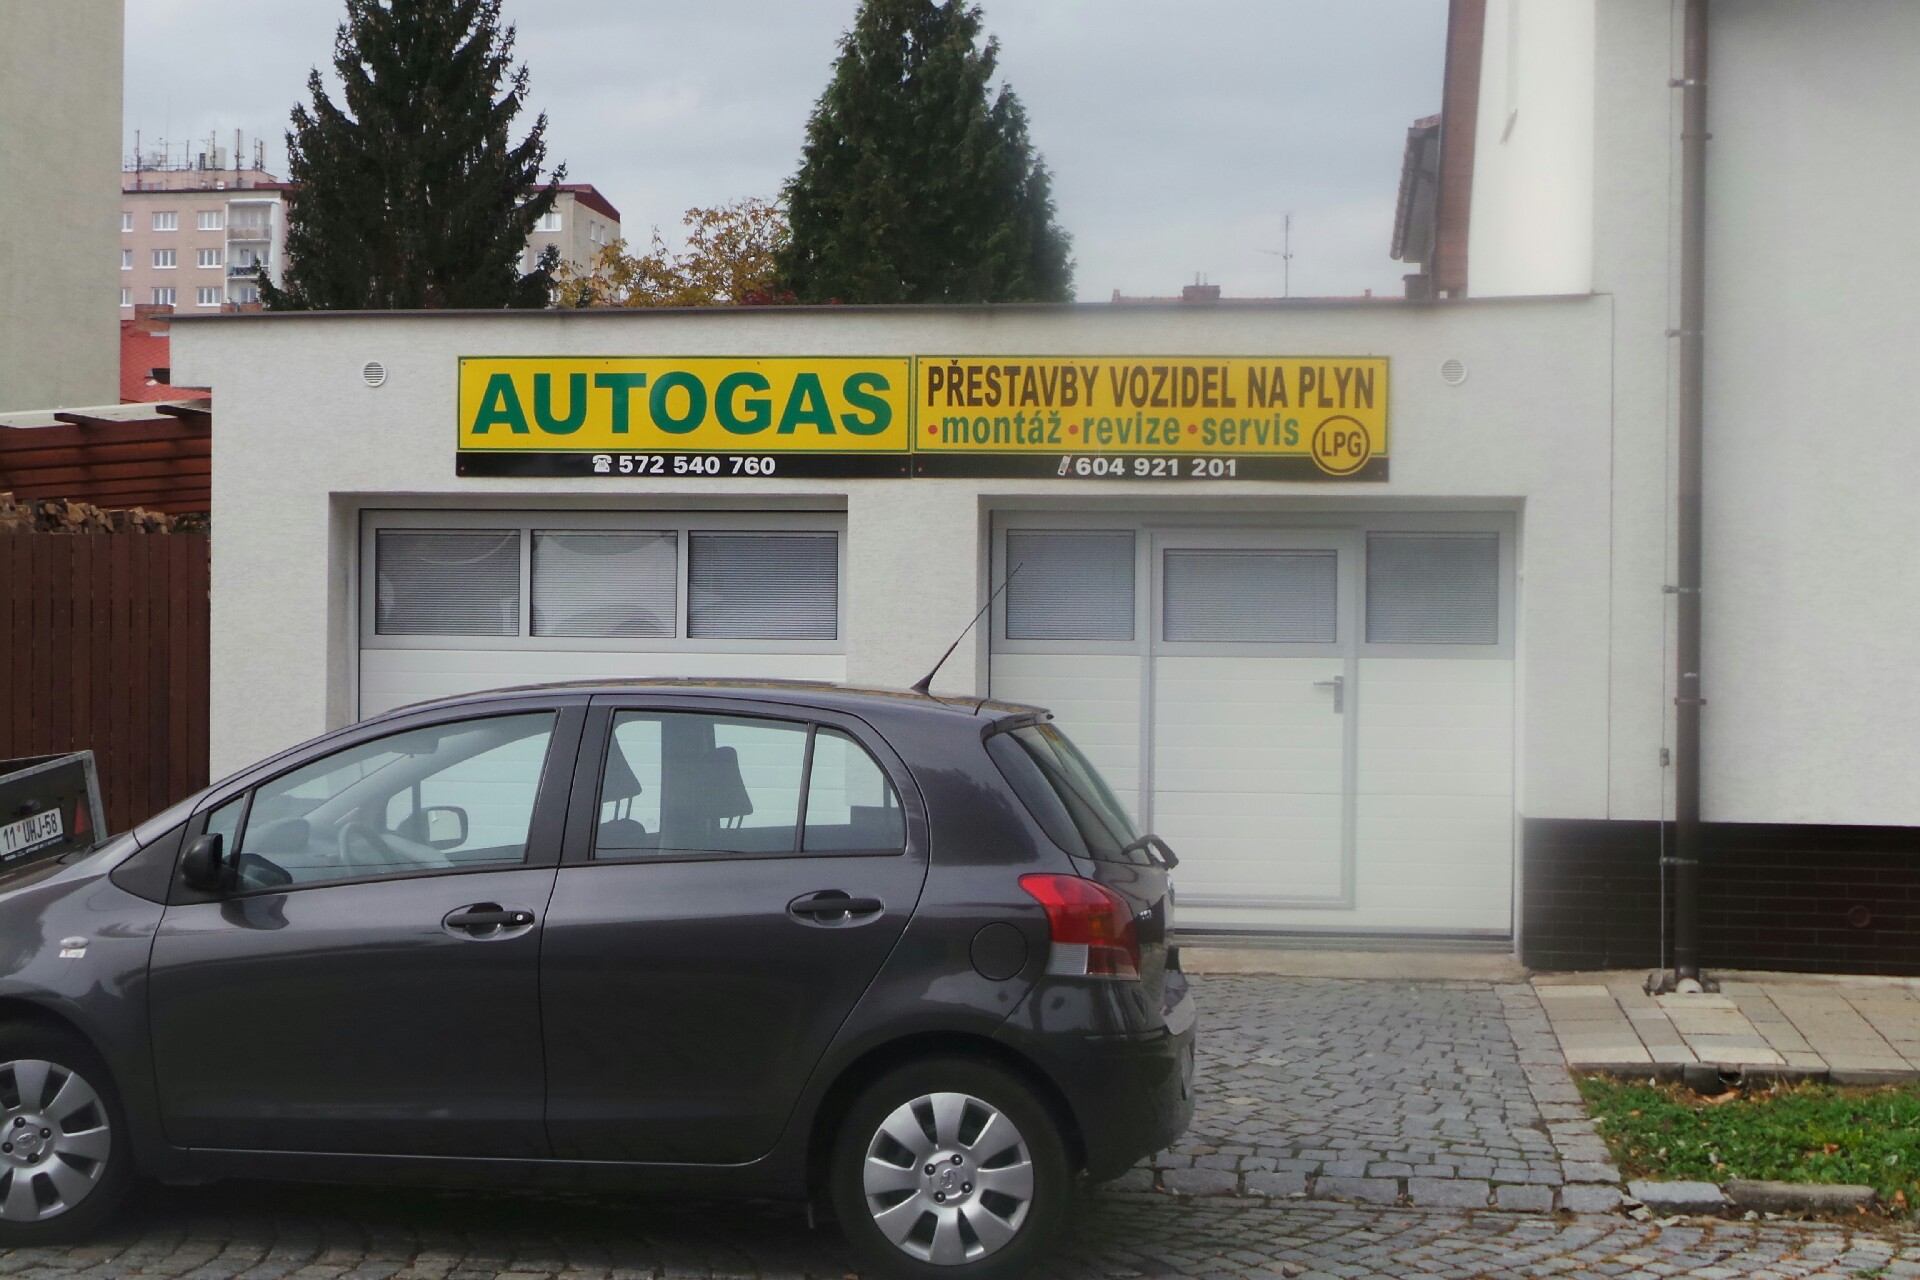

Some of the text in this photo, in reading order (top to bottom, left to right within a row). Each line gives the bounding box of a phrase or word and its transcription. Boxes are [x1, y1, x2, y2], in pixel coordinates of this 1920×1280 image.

[928, 360, 1374, 409] PŘESTAVBY VOZIDEL NA PLYN
[471, 372, 893, 435] AUTOGAS
[942, 411, 1299, 446] montáž revize servis
[1321, 431, 1362, 457] LPG
[618, 456, 776, 475] 572 540 760
[1075, 459, 1236, 477] 604 921 201
